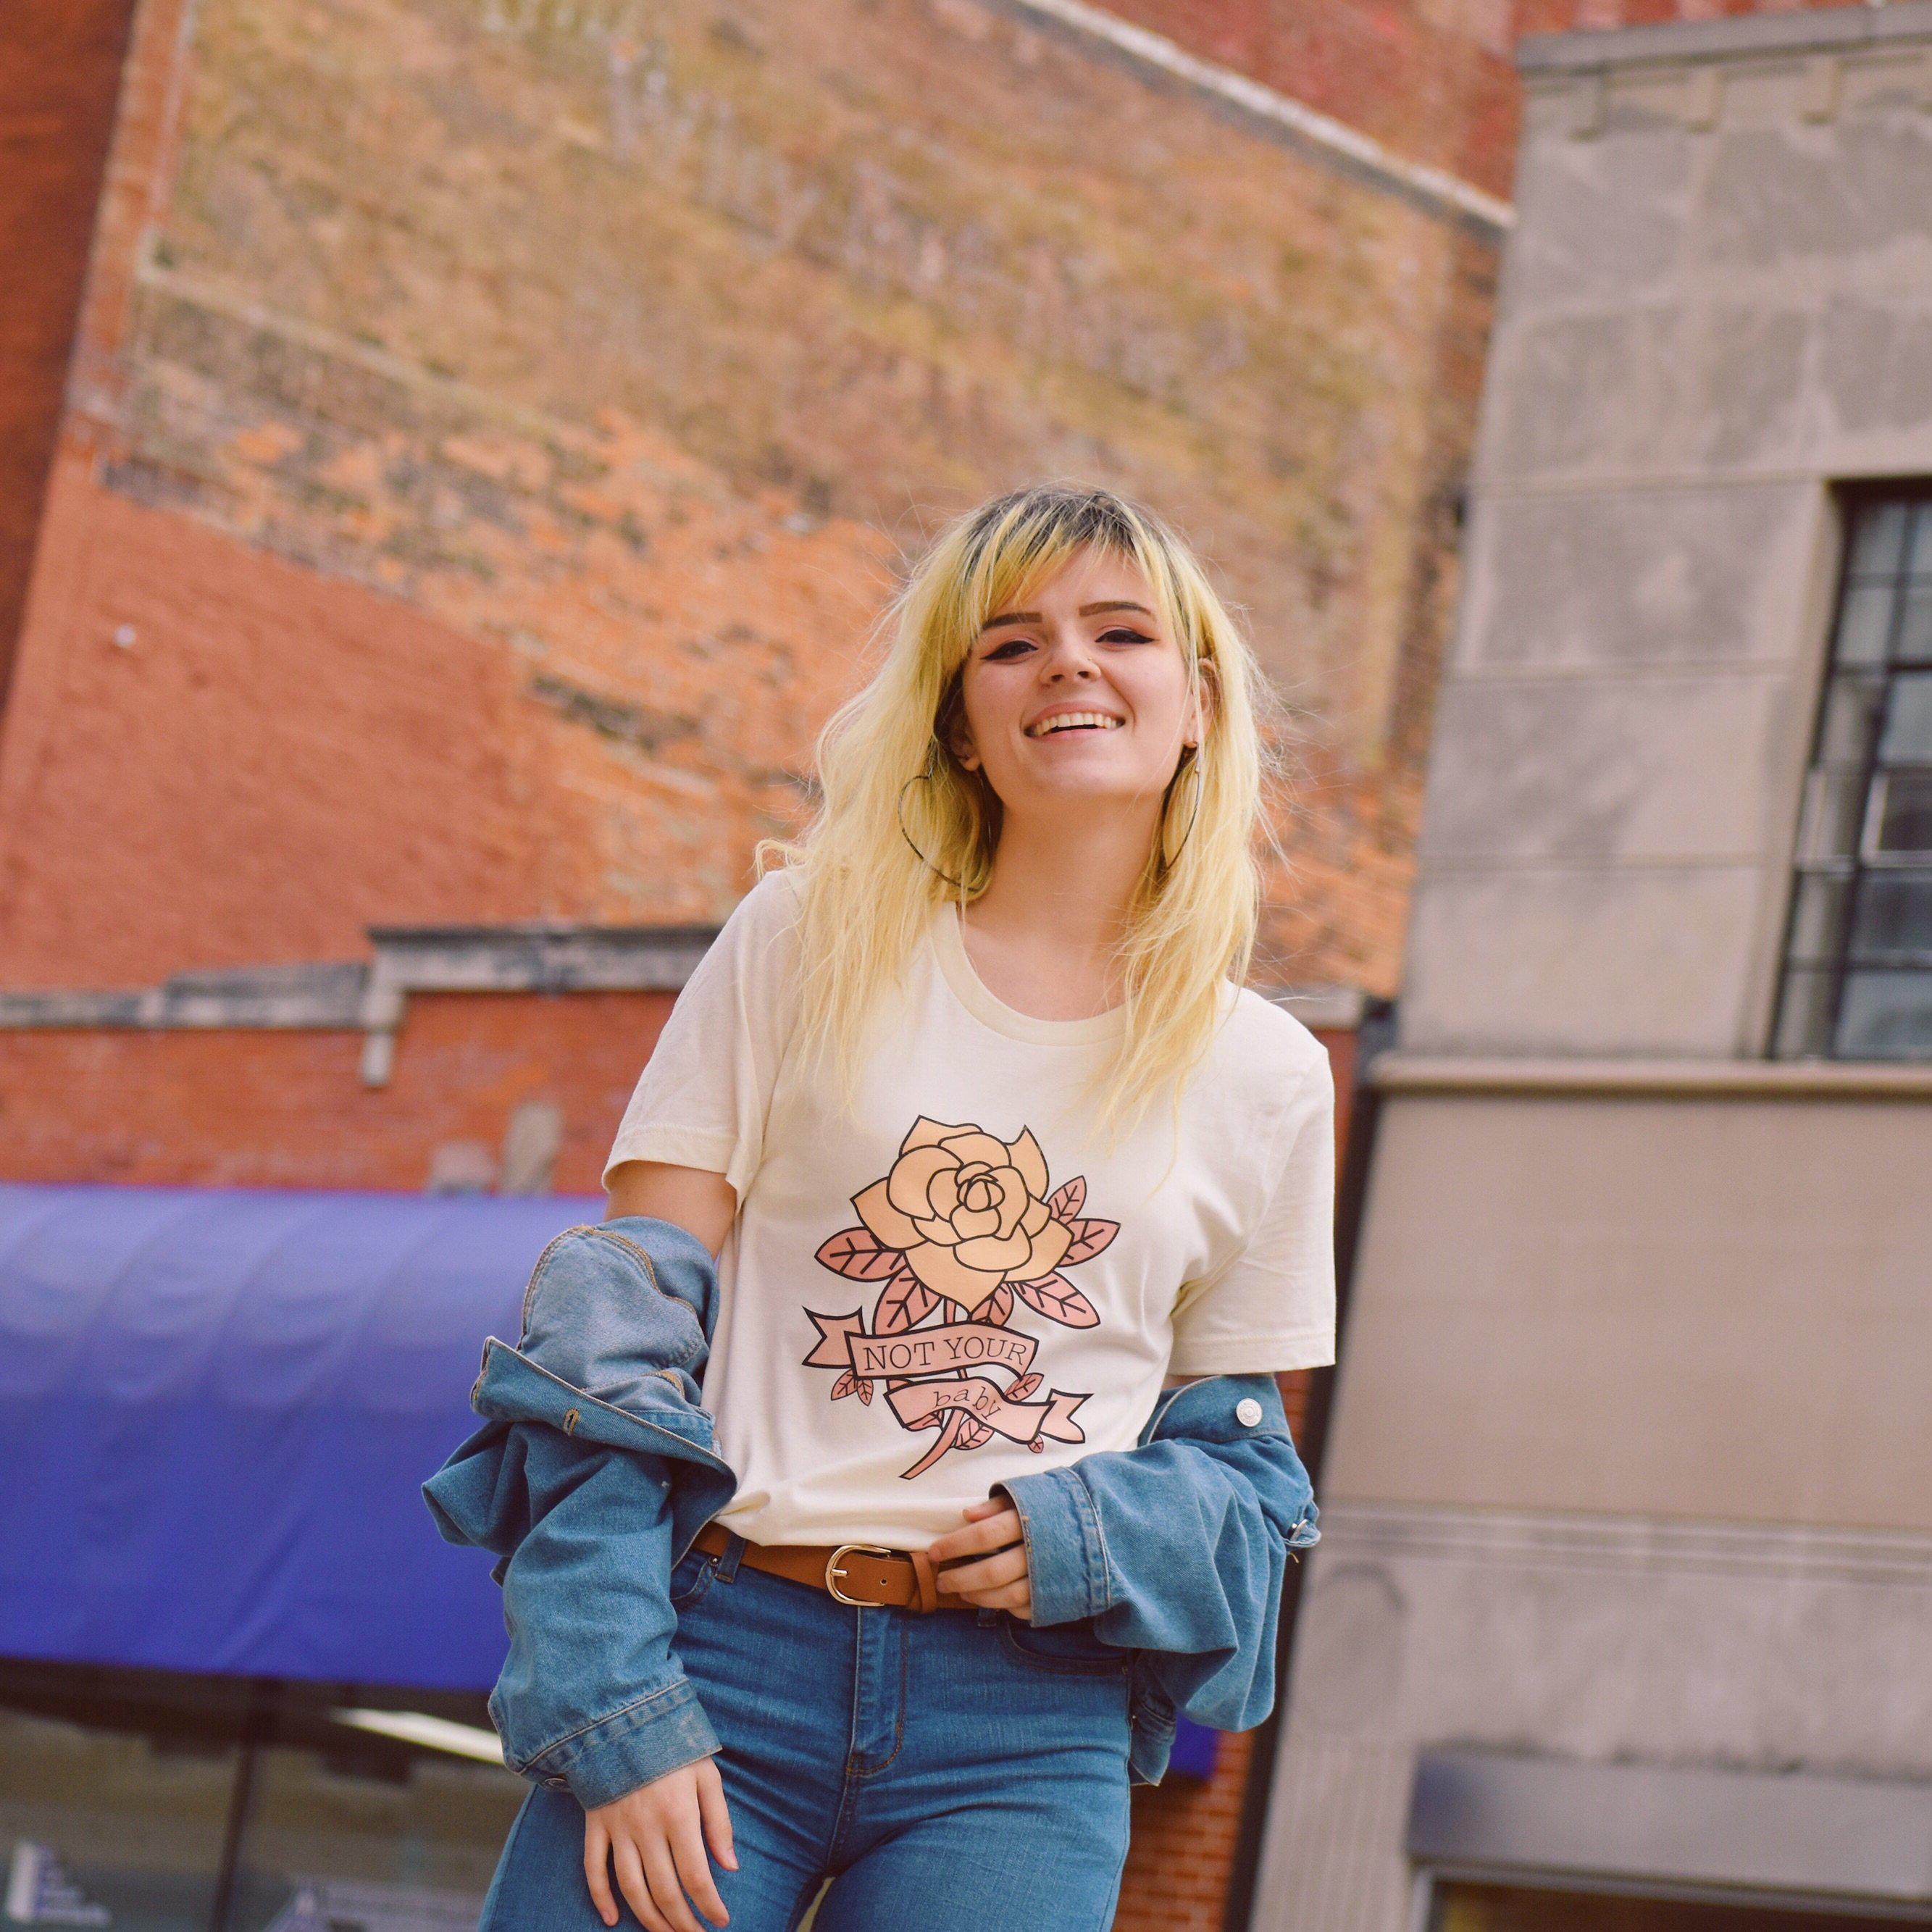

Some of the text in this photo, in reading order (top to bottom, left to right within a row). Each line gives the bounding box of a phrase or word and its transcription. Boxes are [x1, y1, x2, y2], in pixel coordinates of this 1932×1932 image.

[863, 1337, 1026, 1371] NOT YOUR
[933, 1387, 1001, 1420] baby
